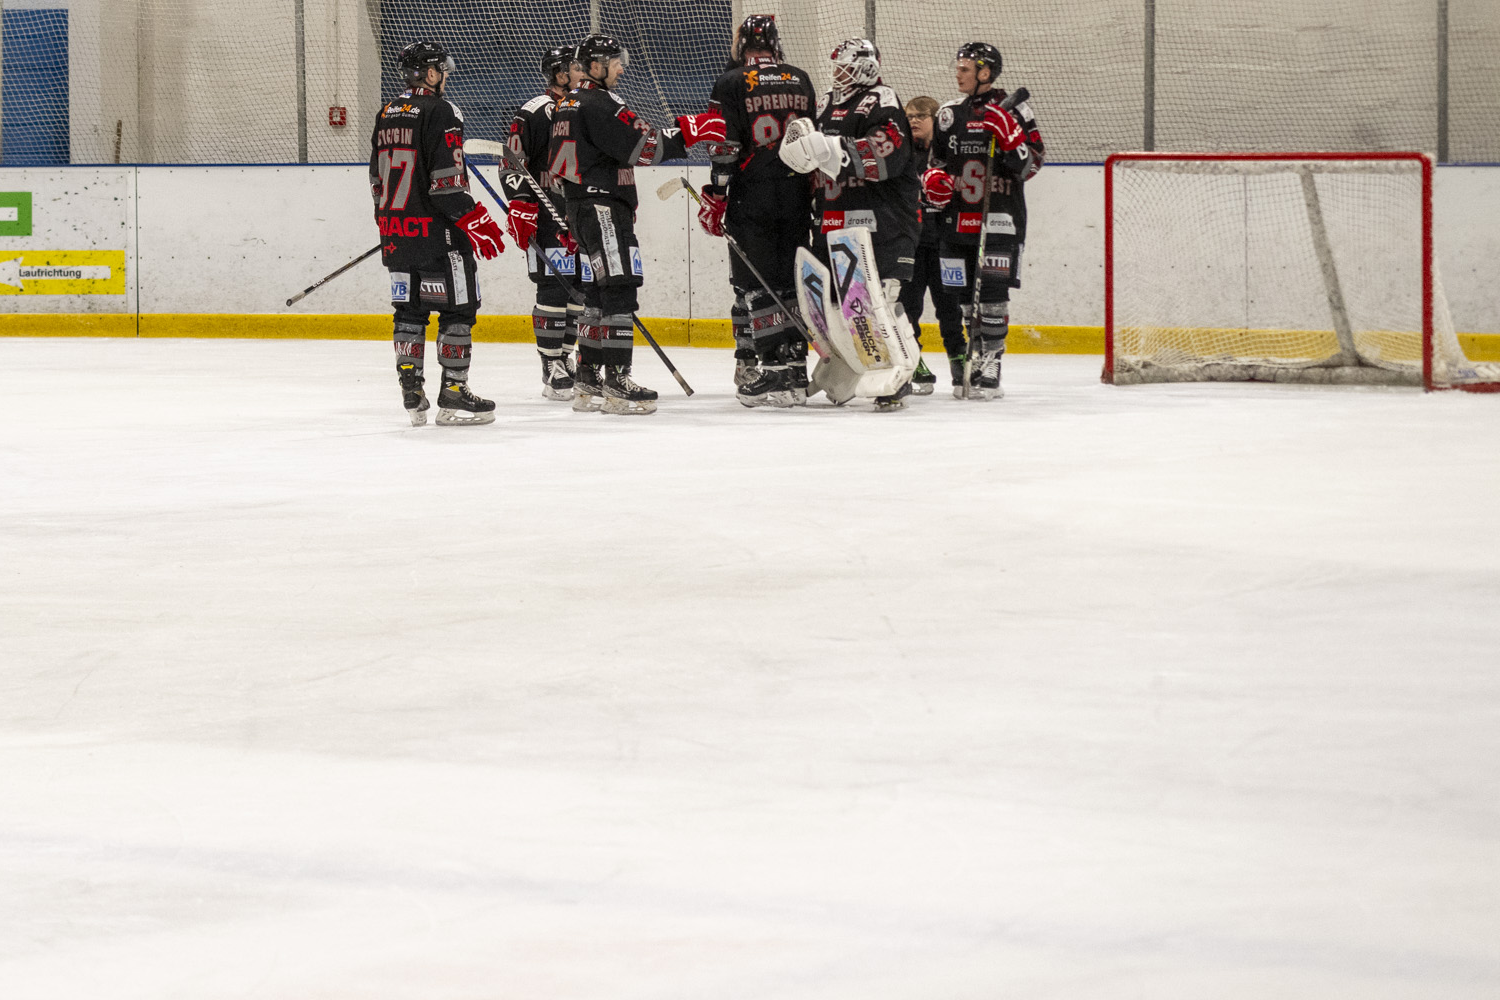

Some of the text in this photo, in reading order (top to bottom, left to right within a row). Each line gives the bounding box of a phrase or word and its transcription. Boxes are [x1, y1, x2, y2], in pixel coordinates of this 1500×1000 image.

[848, 216, 873, 226] droste
[19, 269, 81, 279] Laufrichtung
[852, 317, 873, 356] DESIGN
[860, 316, 879, 353] DRUCK
